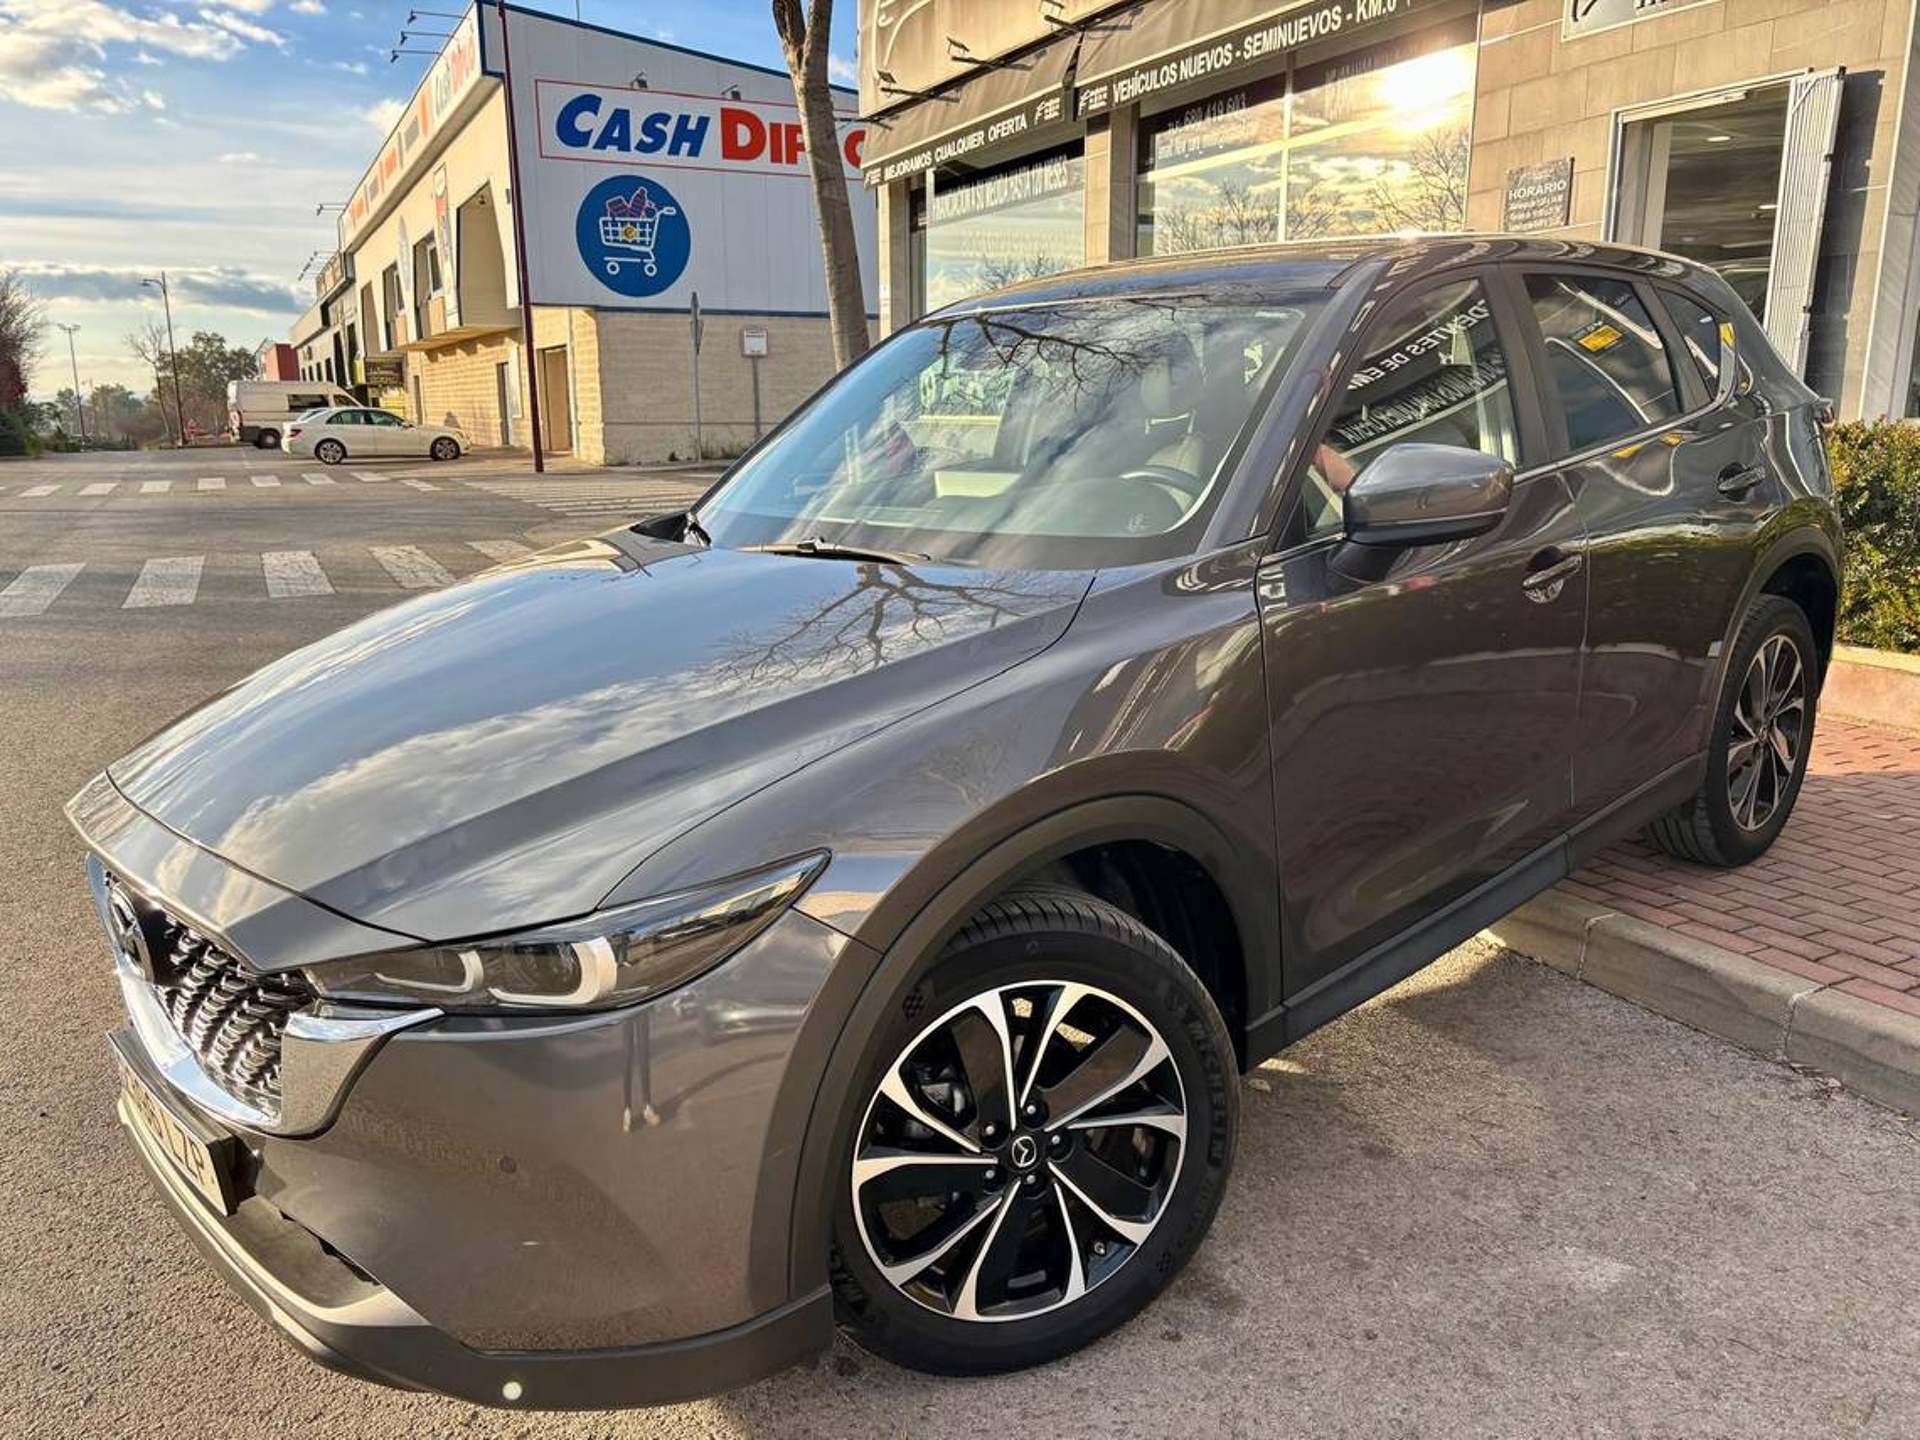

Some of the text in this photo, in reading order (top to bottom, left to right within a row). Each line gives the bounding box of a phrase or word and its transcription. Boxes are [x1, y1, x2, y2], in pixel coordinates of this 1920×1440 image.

[1112, 69, 1178, 104] VEHÍCULOS
[1179, 42, 1232, 81] NUEVOS
[1243, 4, 1342, 60] SEMINUEVOS
[555, 93, 867, 169] CASH DIP
[883, 151, 932, 181] MEJORAMOS
[934, 130, 984, 162] CUALQUIER
[988, 113, 1027, 143] OFERTA
[1508, 180, 1567, 200] HORARIO
